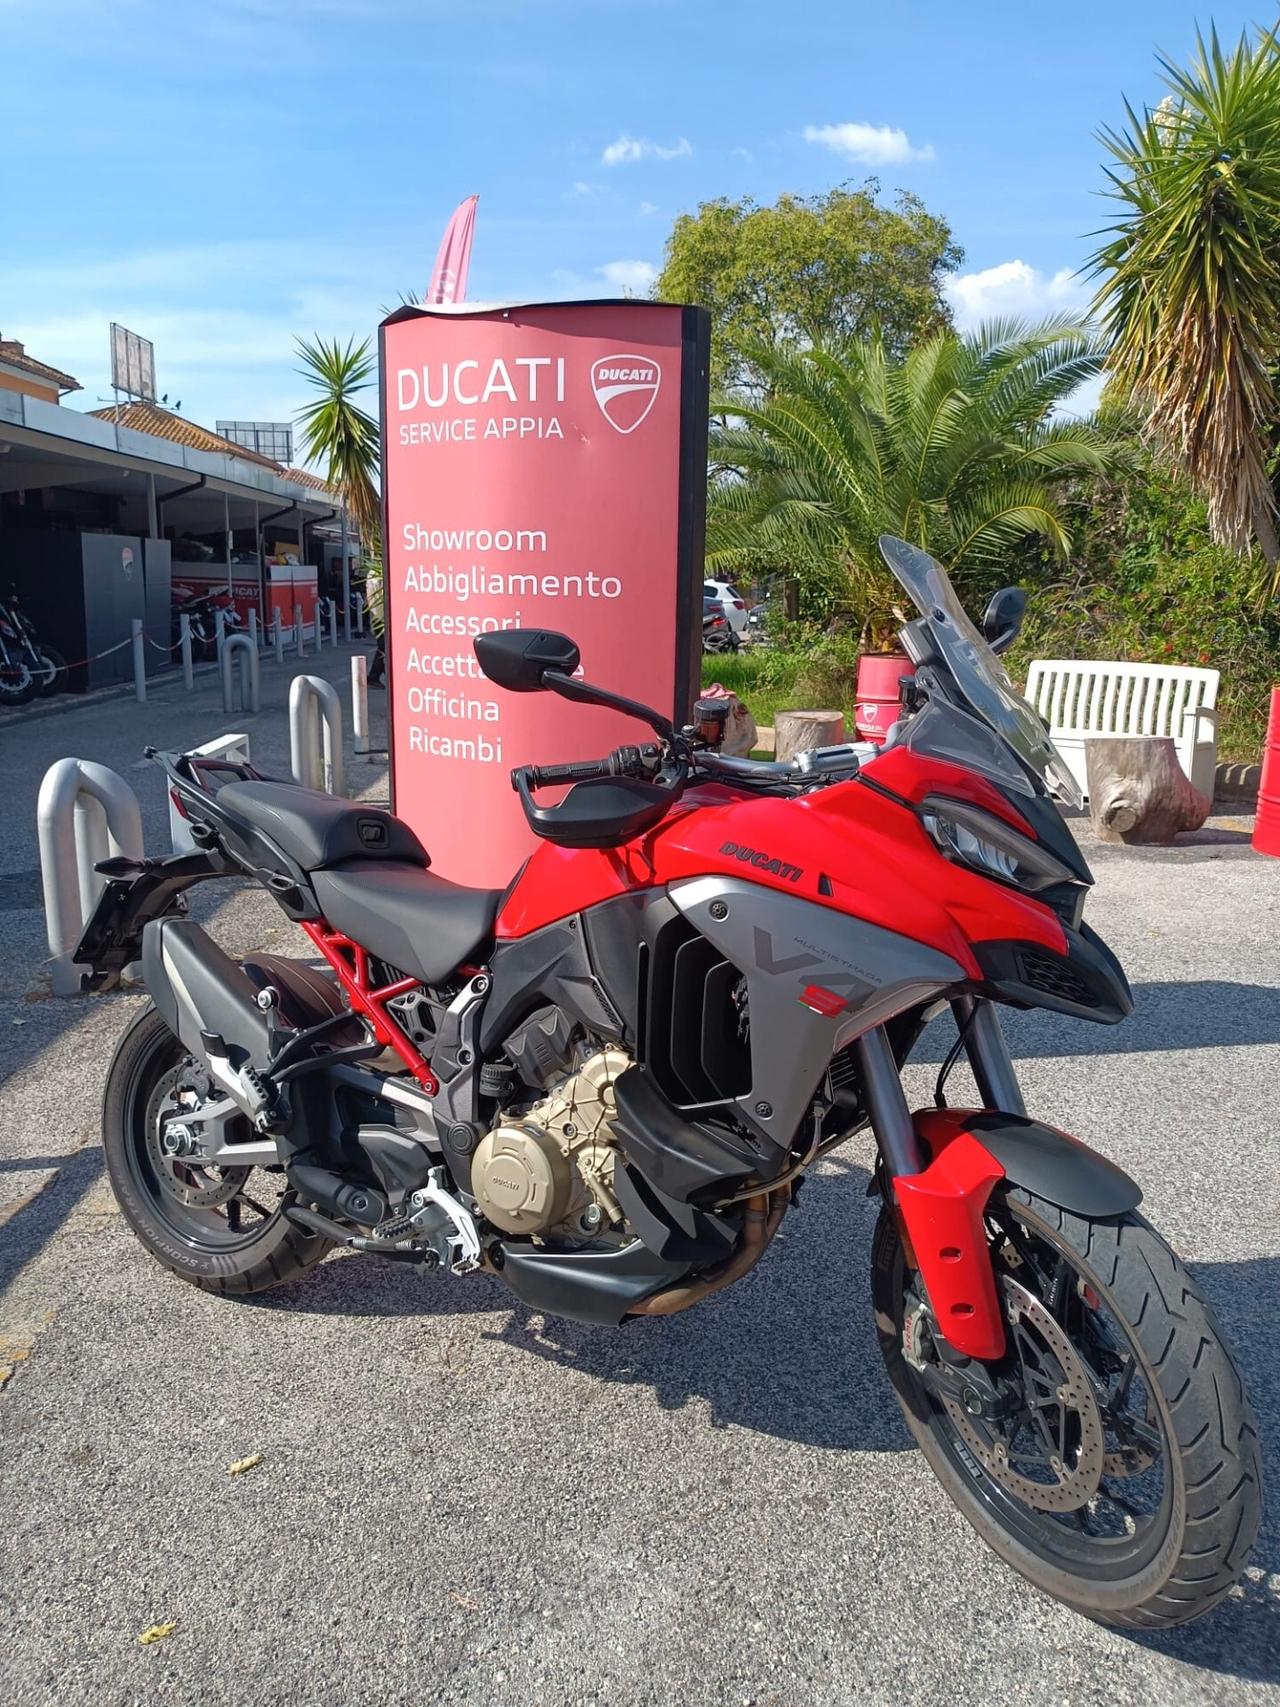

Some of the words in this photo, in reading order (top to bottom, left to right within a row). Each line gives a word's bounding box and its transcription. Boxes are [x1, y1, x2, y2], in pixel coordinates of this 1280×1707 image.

[397, 357, 566, 411] DUCATI
[598, 368, 653, 381] DUCATI
[399, 418, 477, 446] SERVICE
[484, 417, 565, 439] APPIA
[402, 523, 548, 552] Showroom
[404, 565, 622, 602] Abbigliamento
[405, 607, 521, 637] Accessori
[407, 687, 500, 722] Officina
[409, 726, 503, 763] Ricambi
[720, 841, 804, 883] DUCATI
[794, 935, 883, 985] MULTISTRADA
[138, 1219, 199, 1268] SCORPION
